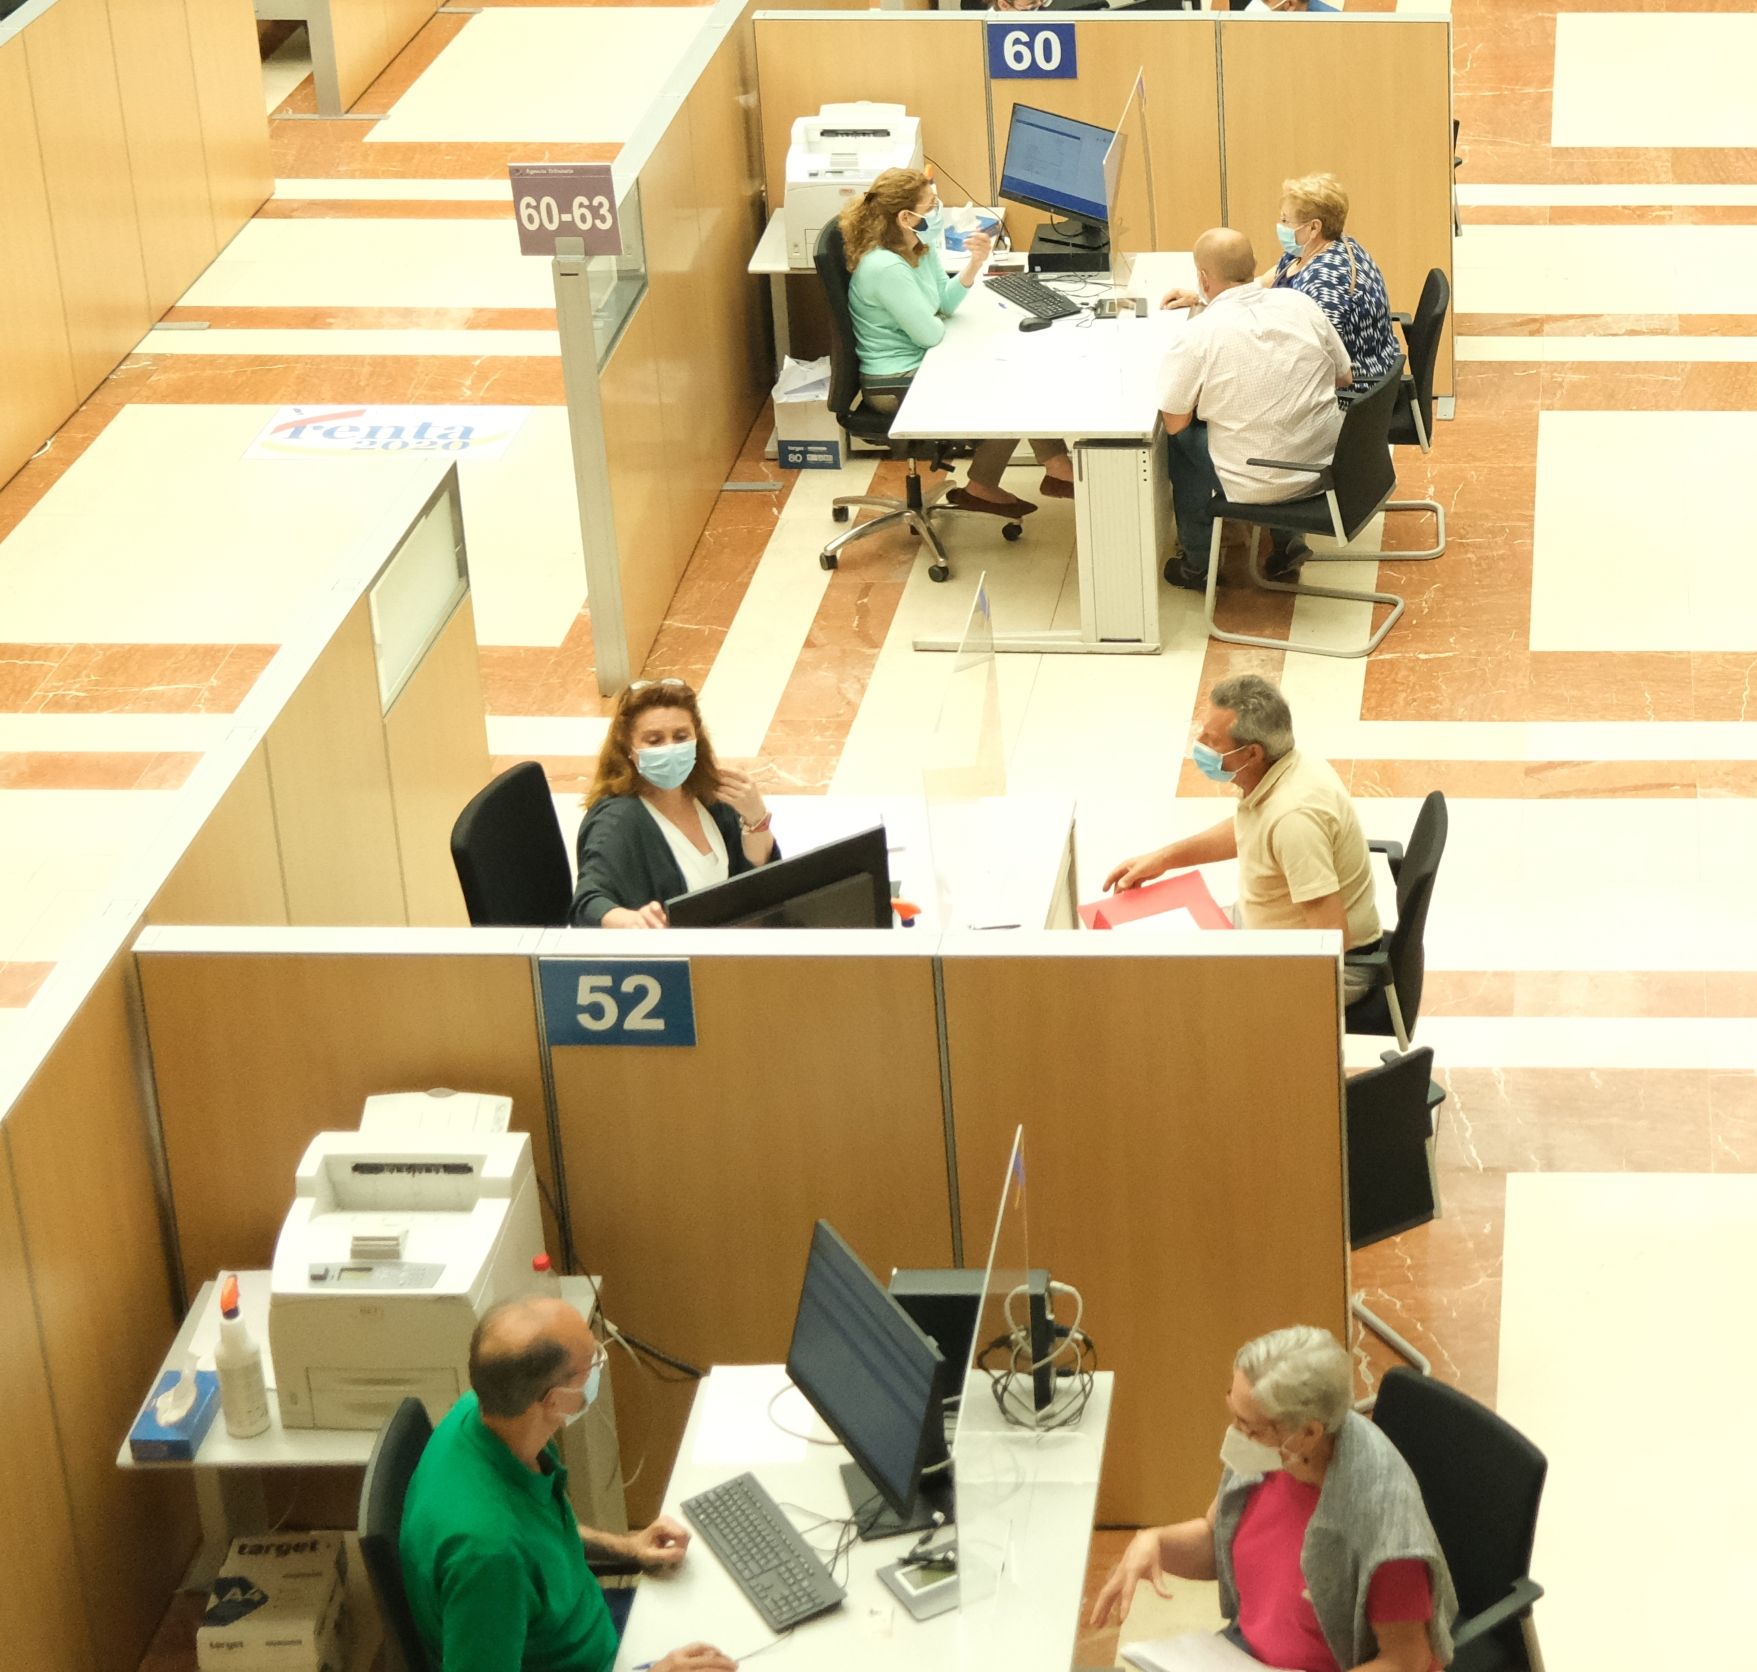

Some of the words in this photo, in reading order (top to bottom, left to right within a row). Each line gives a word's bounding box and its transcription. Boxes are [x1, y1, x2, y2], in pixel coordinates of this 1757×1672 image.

[1003, 30, 1062, 71] 60
[520, 195, 613, 231] 60-63
[283, 421, 475, 440] renta
[351, 440, 471, 451] 2020
[576, 974, 665, 1031] 52
[238, 1539, 318, 1557] target
